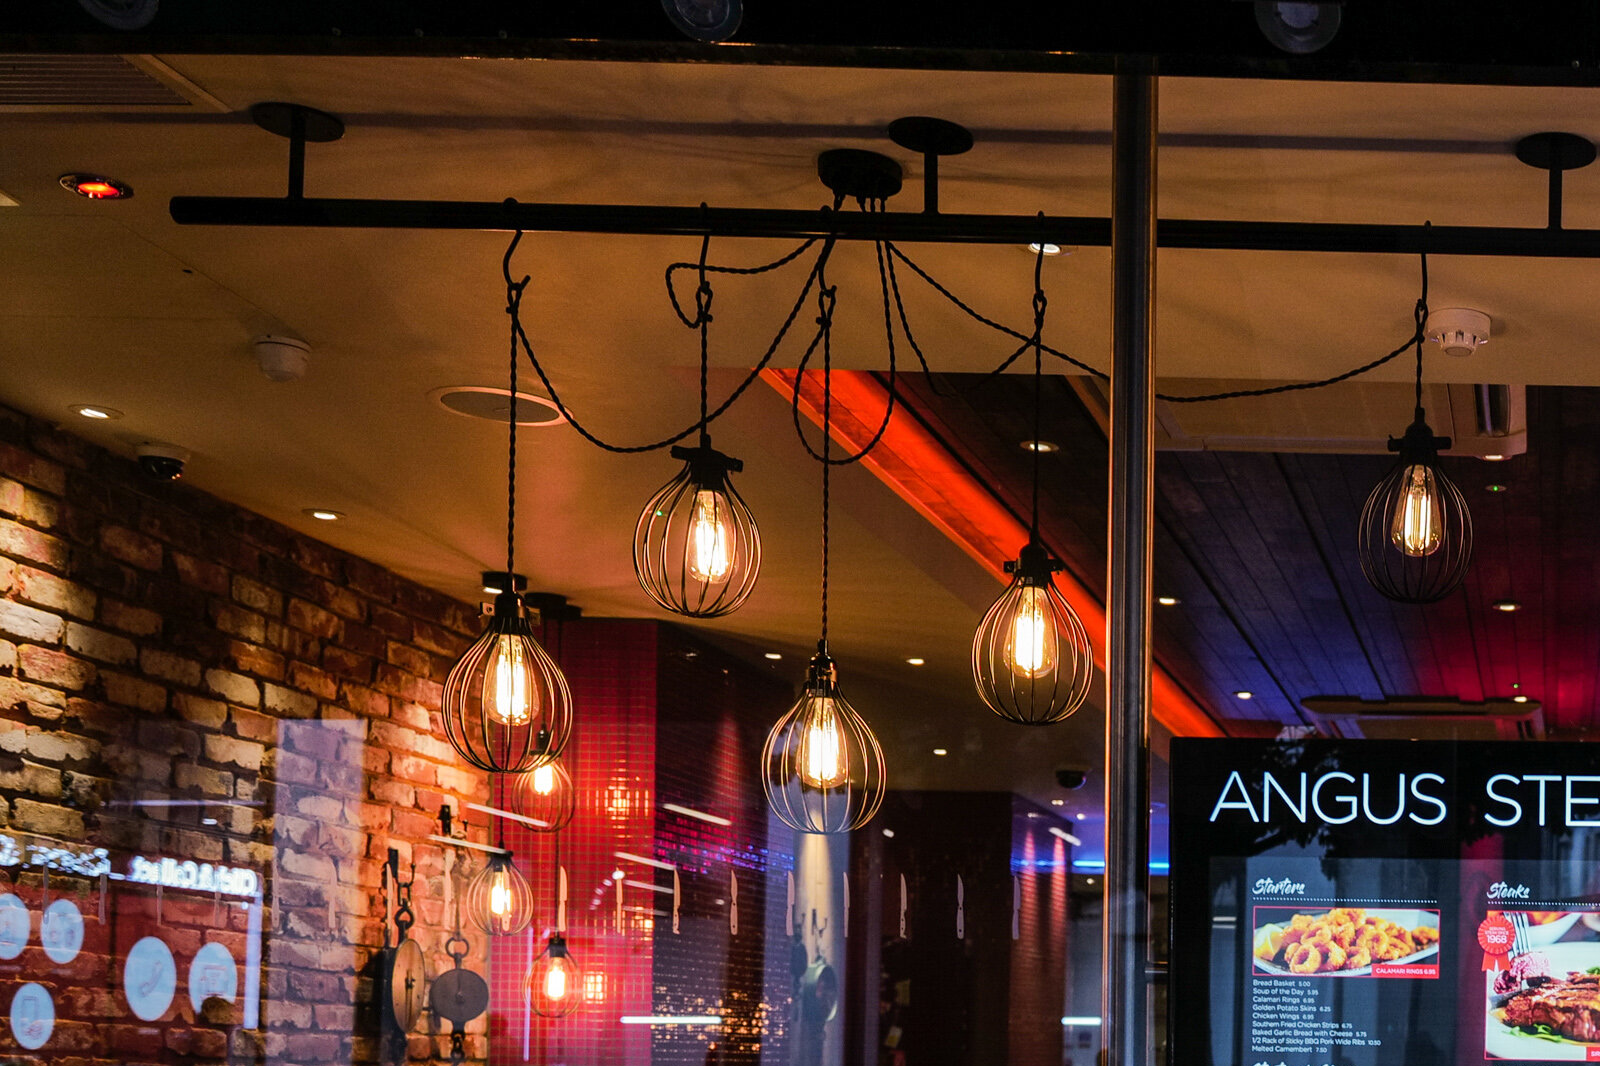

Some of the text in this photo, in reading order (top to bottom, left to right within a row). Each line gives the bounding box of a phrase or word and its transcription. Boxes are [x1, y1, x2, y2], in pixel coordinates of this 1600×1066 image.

[1210, 771, 1447, 826] ANGUS
[1252, 877, 1305, 895] Starters
[1487, 881, 1530, 899] Steaks
[1487, 935, 1507, 943] 1968
[1253, 988, 1269, 996] Soup
